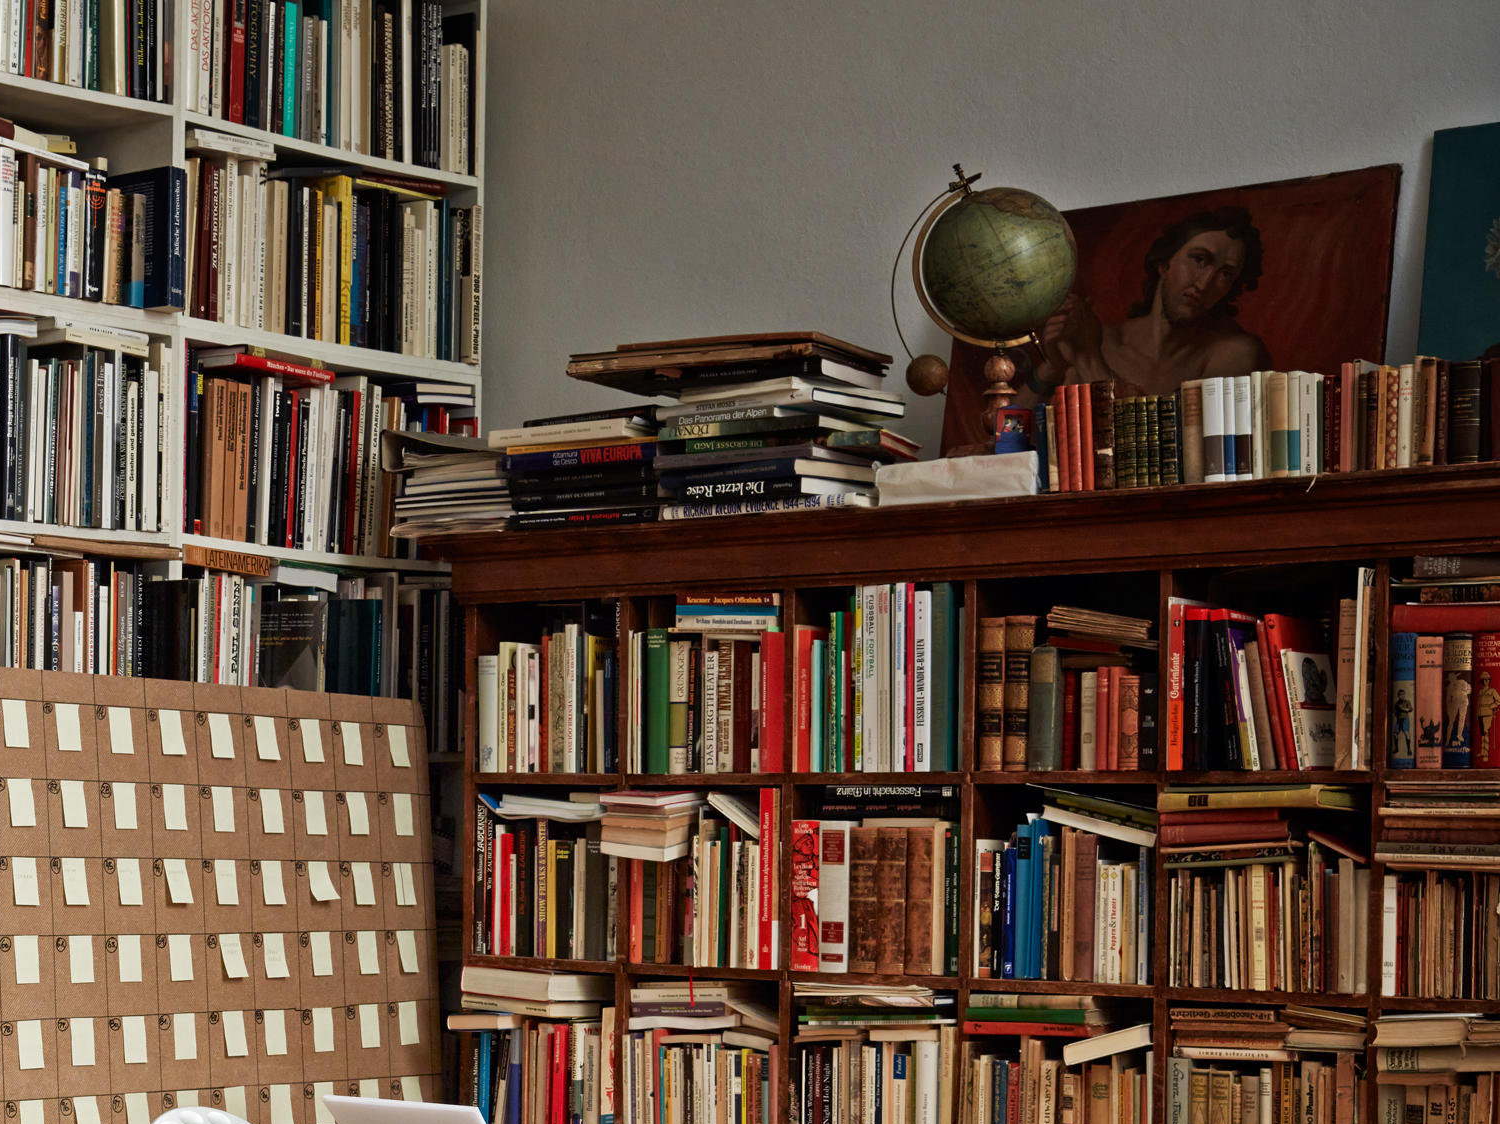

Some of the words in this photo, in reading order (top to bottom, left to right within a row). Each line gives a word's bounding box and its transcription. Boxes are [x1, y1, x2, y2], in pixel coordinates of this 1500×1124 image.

[472, 293, 480, 355] SPIEGEL-Photos
[679, 417, 693, 425] Das
[695, 412, 731, 424] Panorama
[733, 411, 745, 419] der
[747, 408, 767, 418] Alpen
[581, 448, 603, 465] VIVA
[603, 445, 642, 461] EUROPA
[687, 486, 712, 498] Reise
[716, 483, 743, 496] letzte
[745, 481, 764, 494] Die
[683, 504, 713, 517] RICHARD
[715, 502, 742, 515] AVEDON
[745, 500, 779, 511] EVIDENCE
[205, 551, 270, 577] LATEINAMERIKA
[232, 581, 240, 628] SENN
[231, 634, 239, 673] PAUL
[916, 639, 924, 727] FUSSBALL-WUNDER-BAUTEN
[706, 656, 714, 744] BURGTHEATER
[706, 747, 714, 766] DAS
[539, 822, 547, 857] MONSTER
[539, 866, 547, 895] FREAKS
[539, 899, 547, 922] SHOW
[823, 1064, 831, 1083] Night
[823, 1085, 831, 1102] Holy
[822, 1105, 830, 1124] Night
